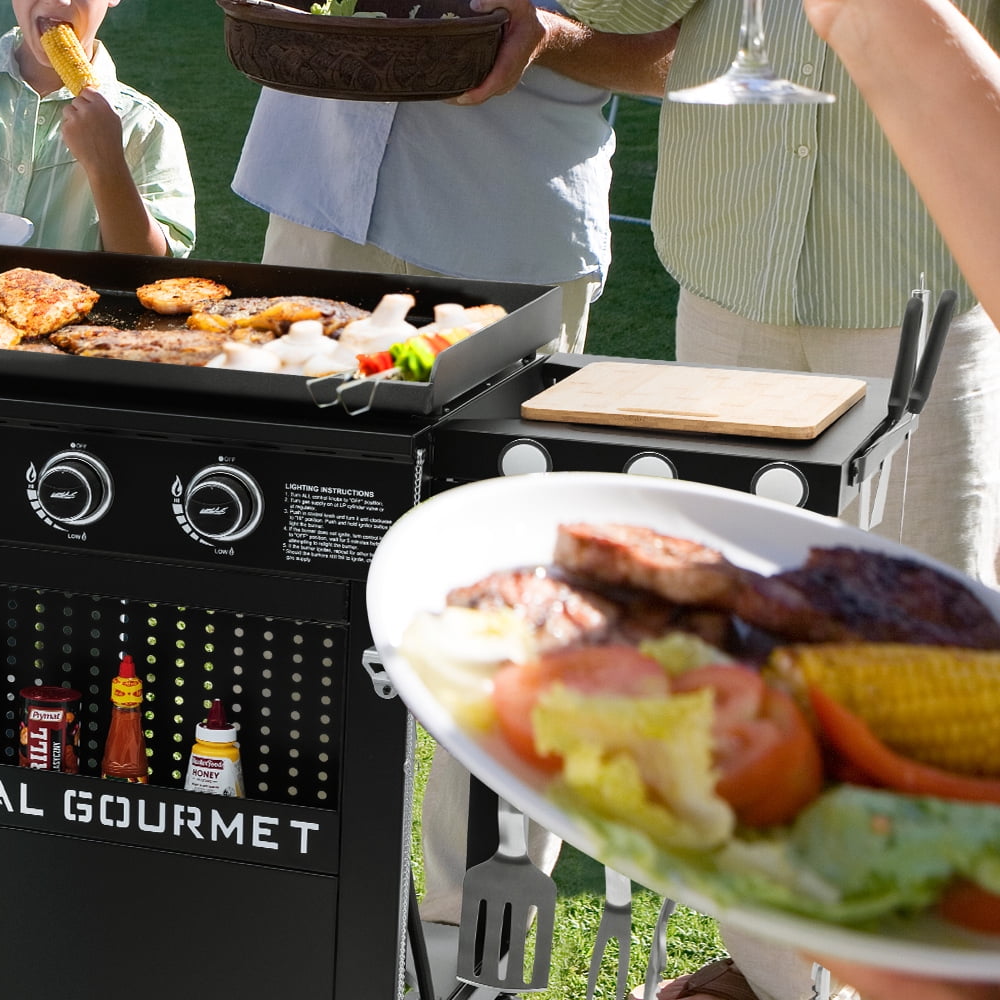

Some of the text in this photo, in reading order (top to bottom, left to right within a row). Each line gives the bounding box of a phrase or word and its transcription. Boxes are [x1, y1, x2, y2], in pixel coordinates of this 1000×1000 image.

[285, 483, 375, 498] LIGHTING INSTRUCTIONS
[33, 711, 60, 720] Prymat
[192, 769, 220, 779] HONEY
[64, 789, 320, 855] GOURMET
